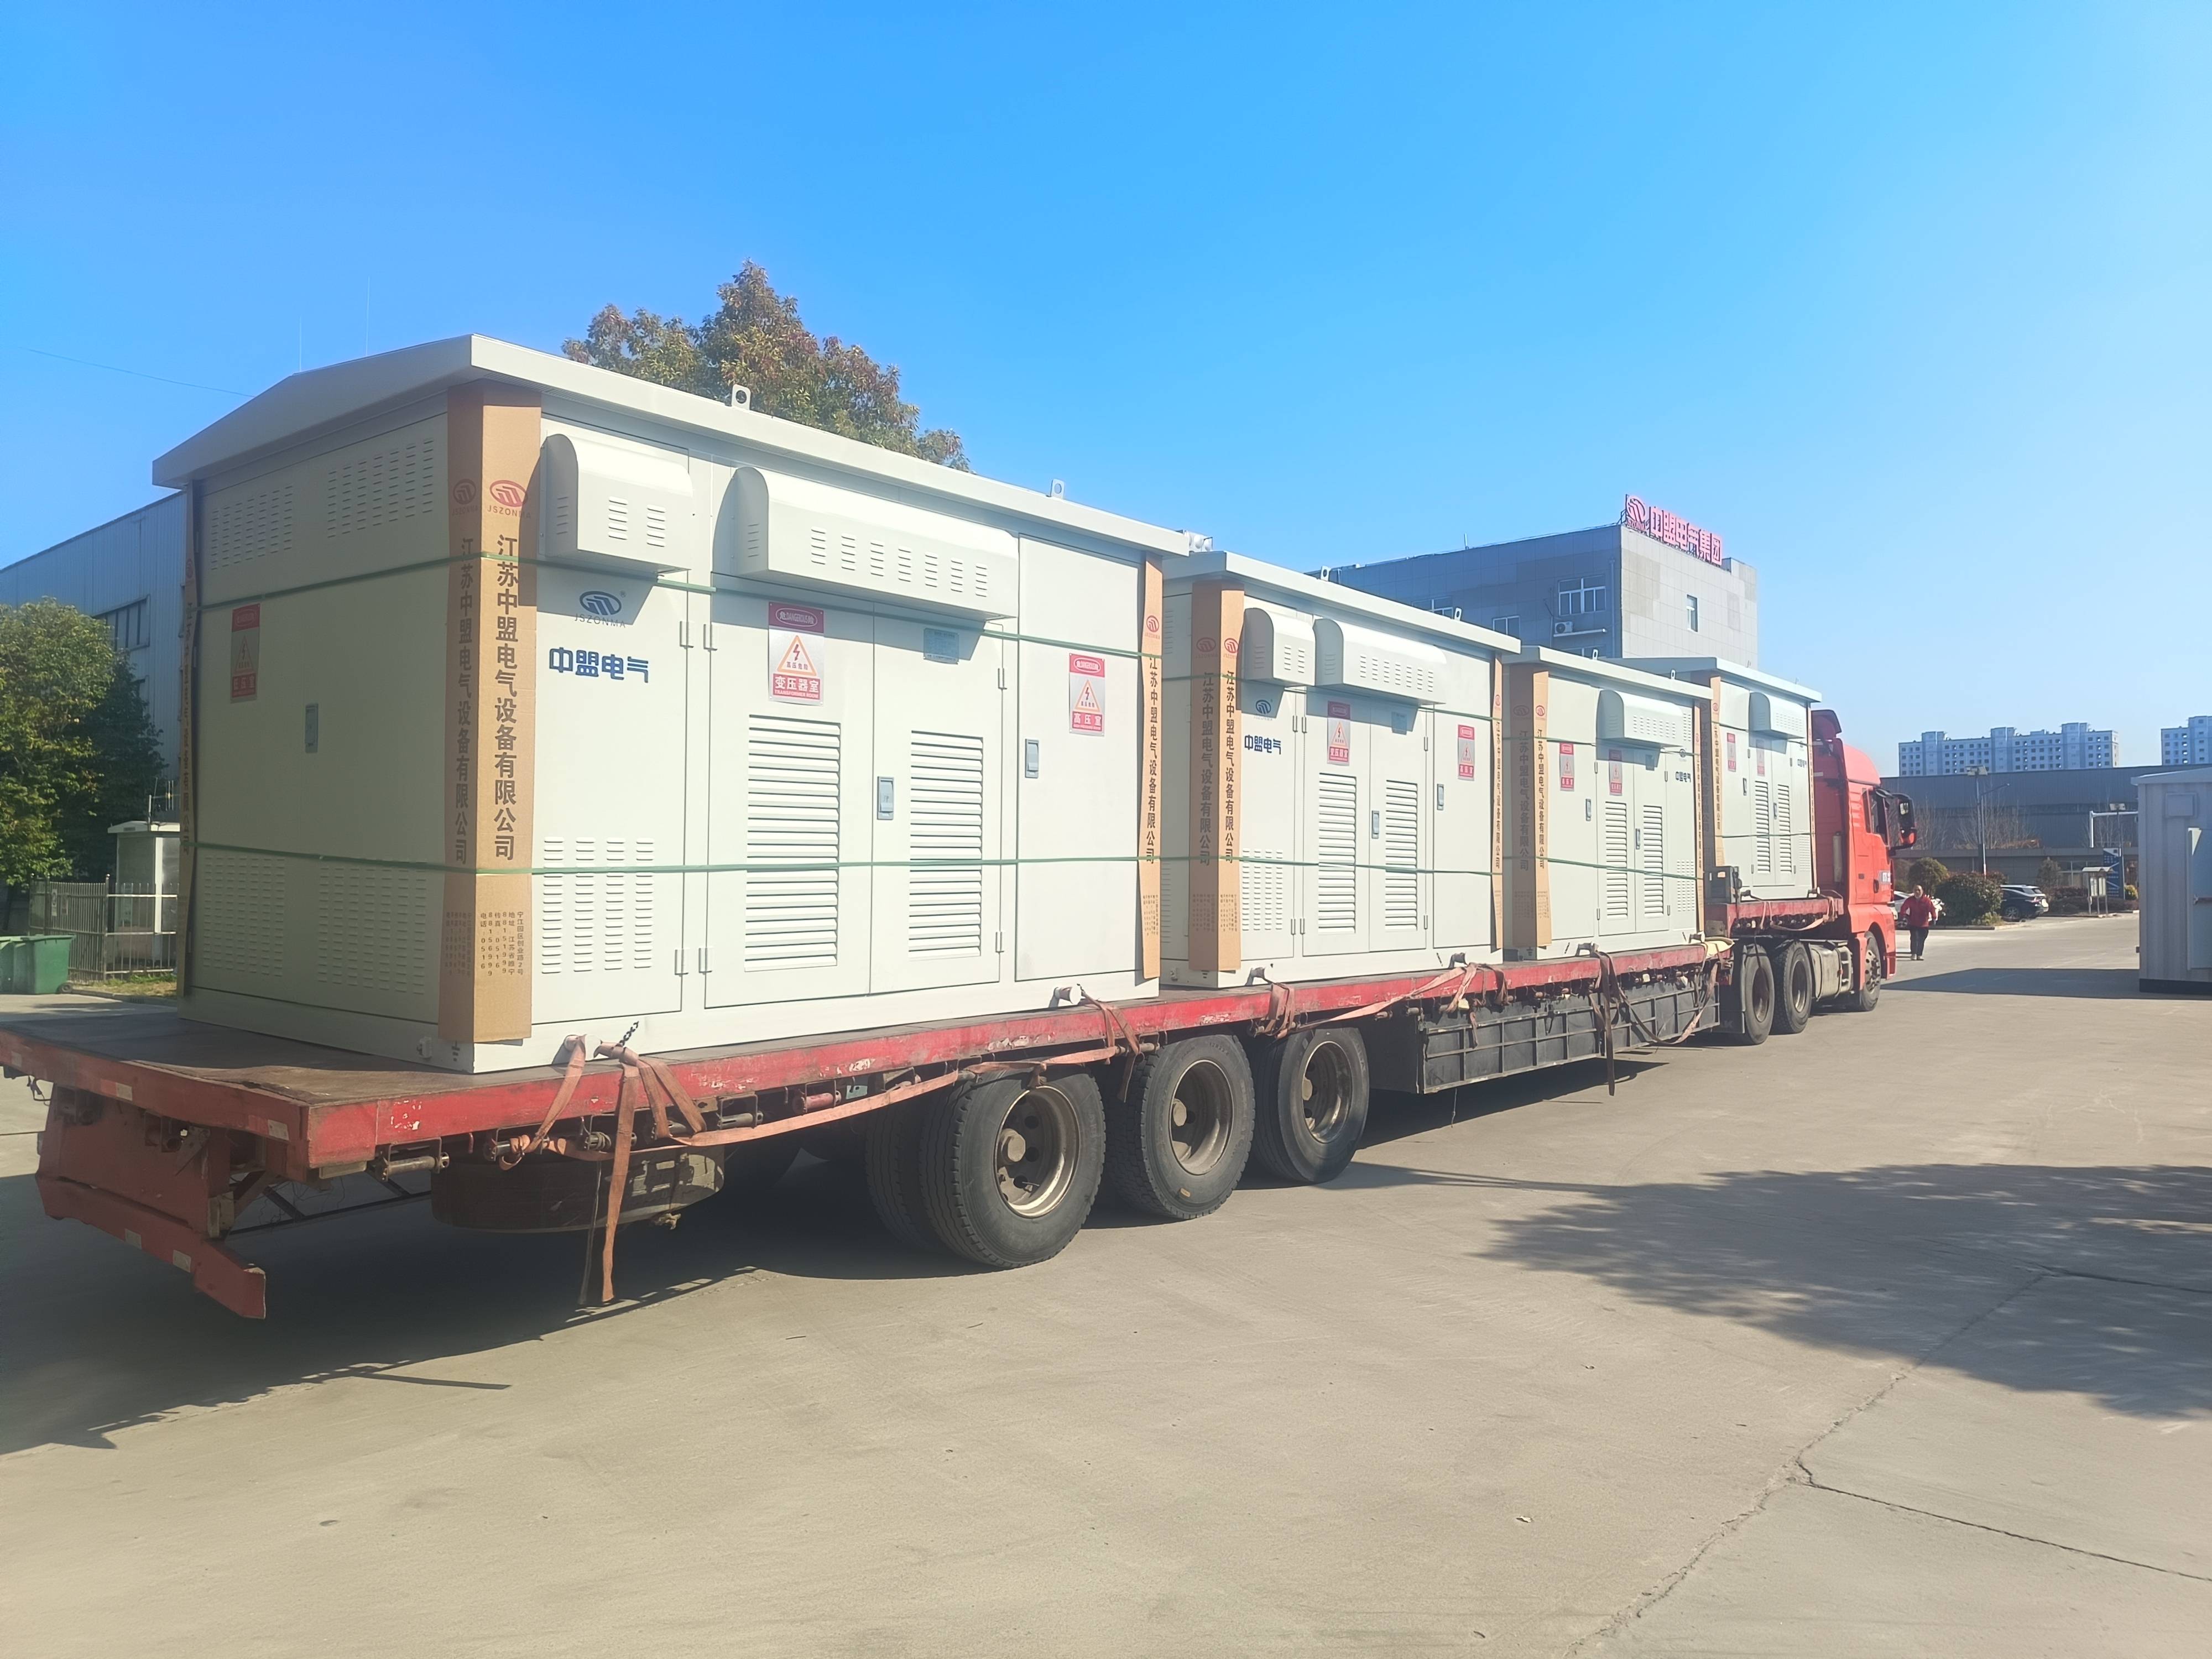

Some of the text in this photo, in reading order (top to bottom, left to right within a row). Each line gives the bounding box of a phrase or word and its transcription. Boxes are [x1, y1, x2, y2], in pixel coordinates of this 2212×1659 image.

[1650, 505, 1722, 566] 中盟电气集团
[575, 613, 626, 629] JSZONMA
[549, 646, 649, 683] 中盟电气
[494, 534, 519, 860] 江苏中盟电气设备有限公司
[775, 676, 819, 693] 变压器室
[1244, 734, 1281, 755] 中盟电气
